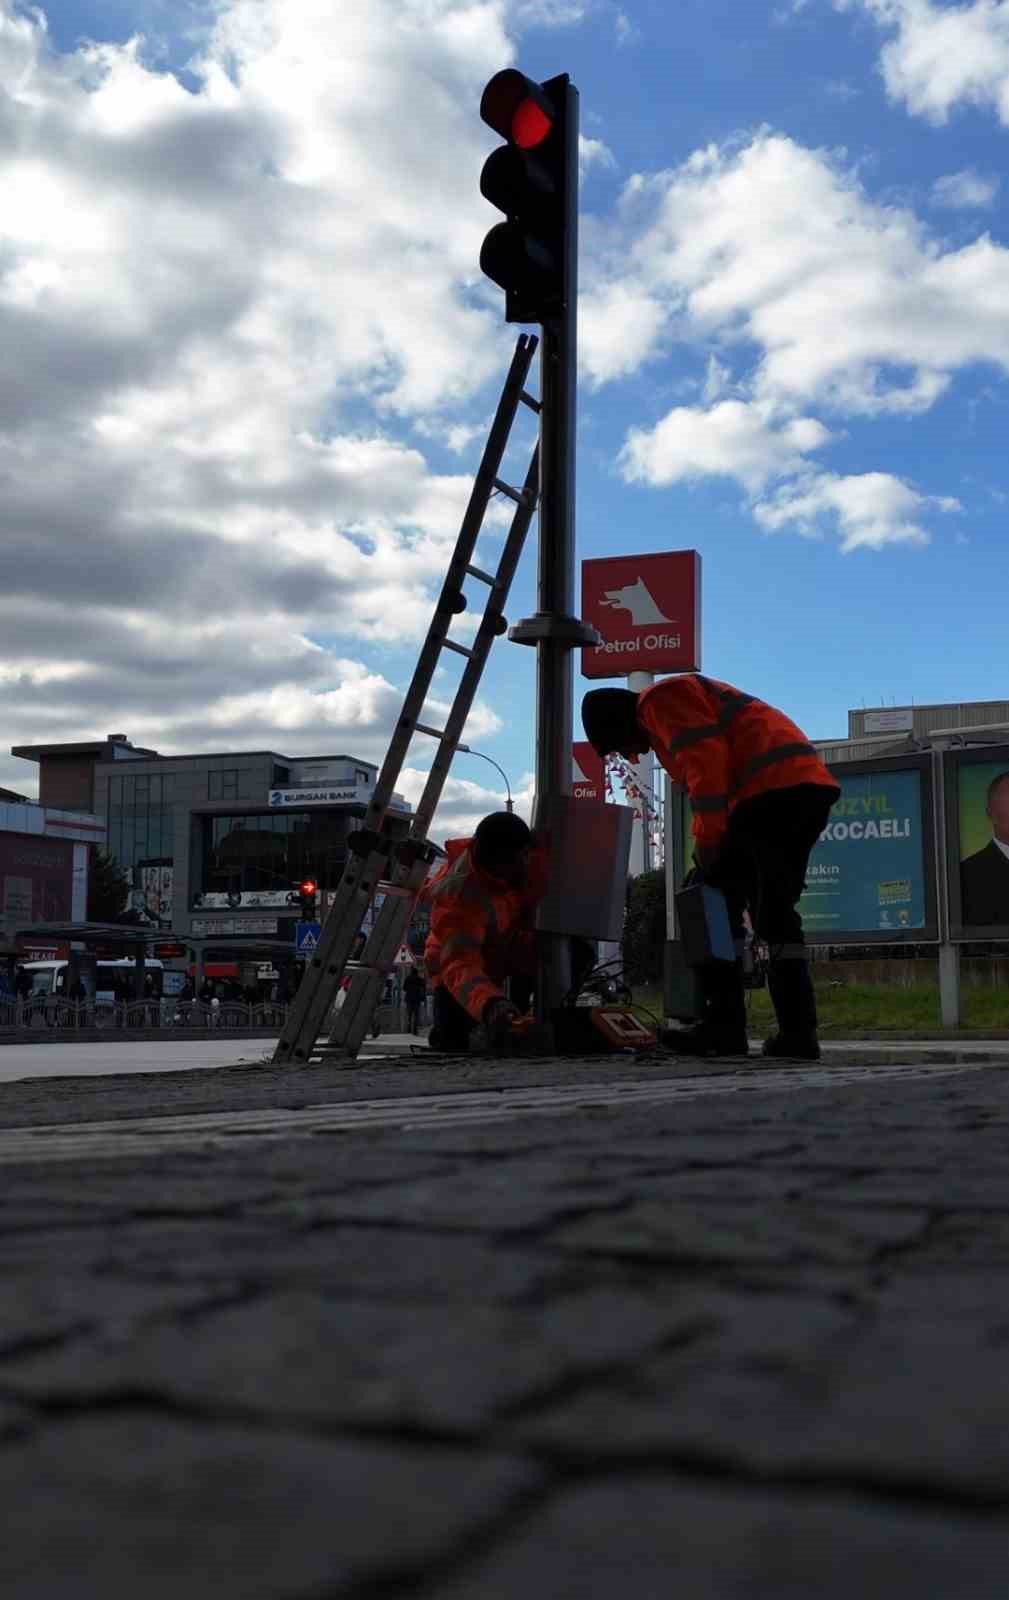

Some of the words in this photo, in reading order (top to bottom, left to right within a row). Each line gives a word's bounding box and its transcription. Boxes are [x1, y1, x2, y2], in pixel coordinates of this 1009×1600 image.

[595, 637, 640, 655] Petrol
[644, 634, 681, 650] Ofisi
[284, 791, 327, 802] BURGAN
[329, 790, 358, 800] BANK
